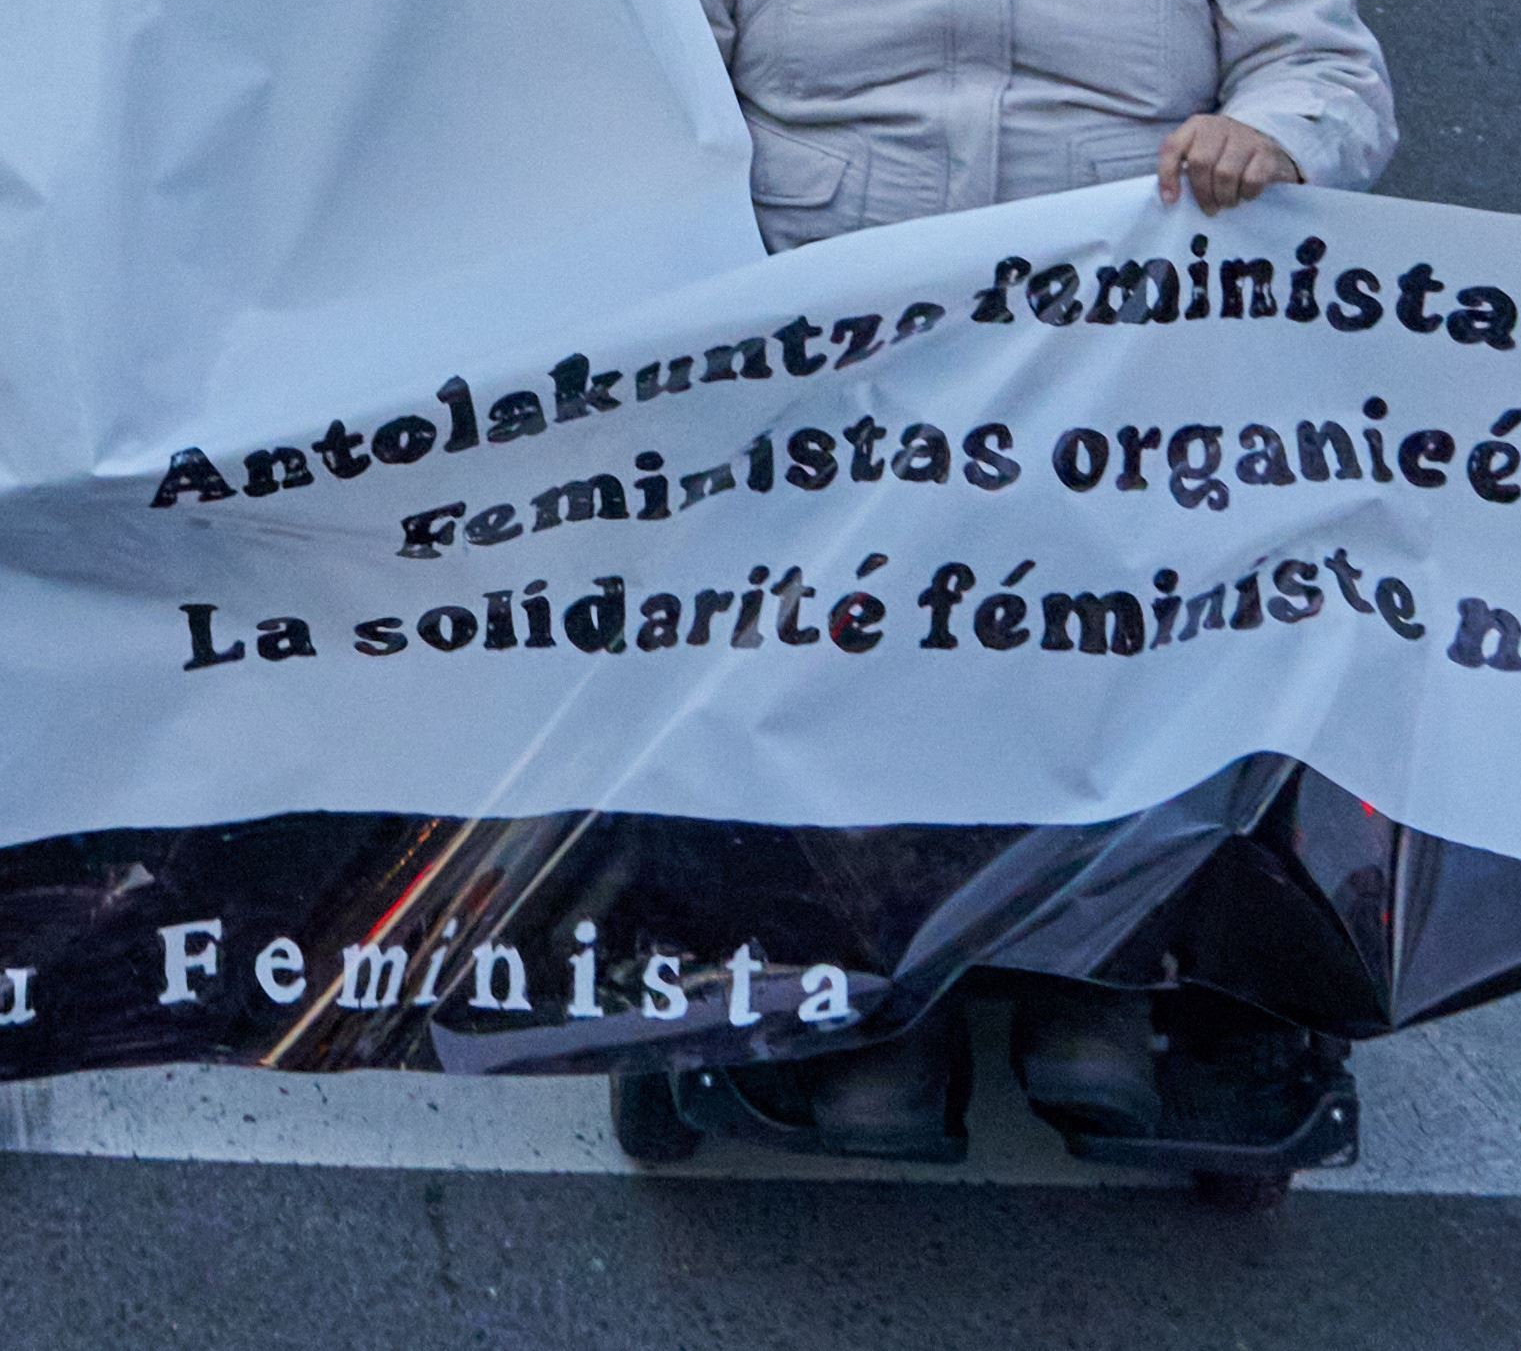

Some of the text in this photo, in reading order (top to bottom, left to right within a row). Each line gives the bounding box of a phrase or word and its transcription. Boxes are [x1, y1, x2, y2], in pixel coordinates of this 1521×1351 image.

[971, 234, 1517, 350] feminista
[397, 414, 1020, 559] Feministas
[179, 601, 317, 671] La
[354, 553, 889, 656] solidarité
[918, 546, 1425, 656] féministe
[161, 909, 850, 1027] Feminista
